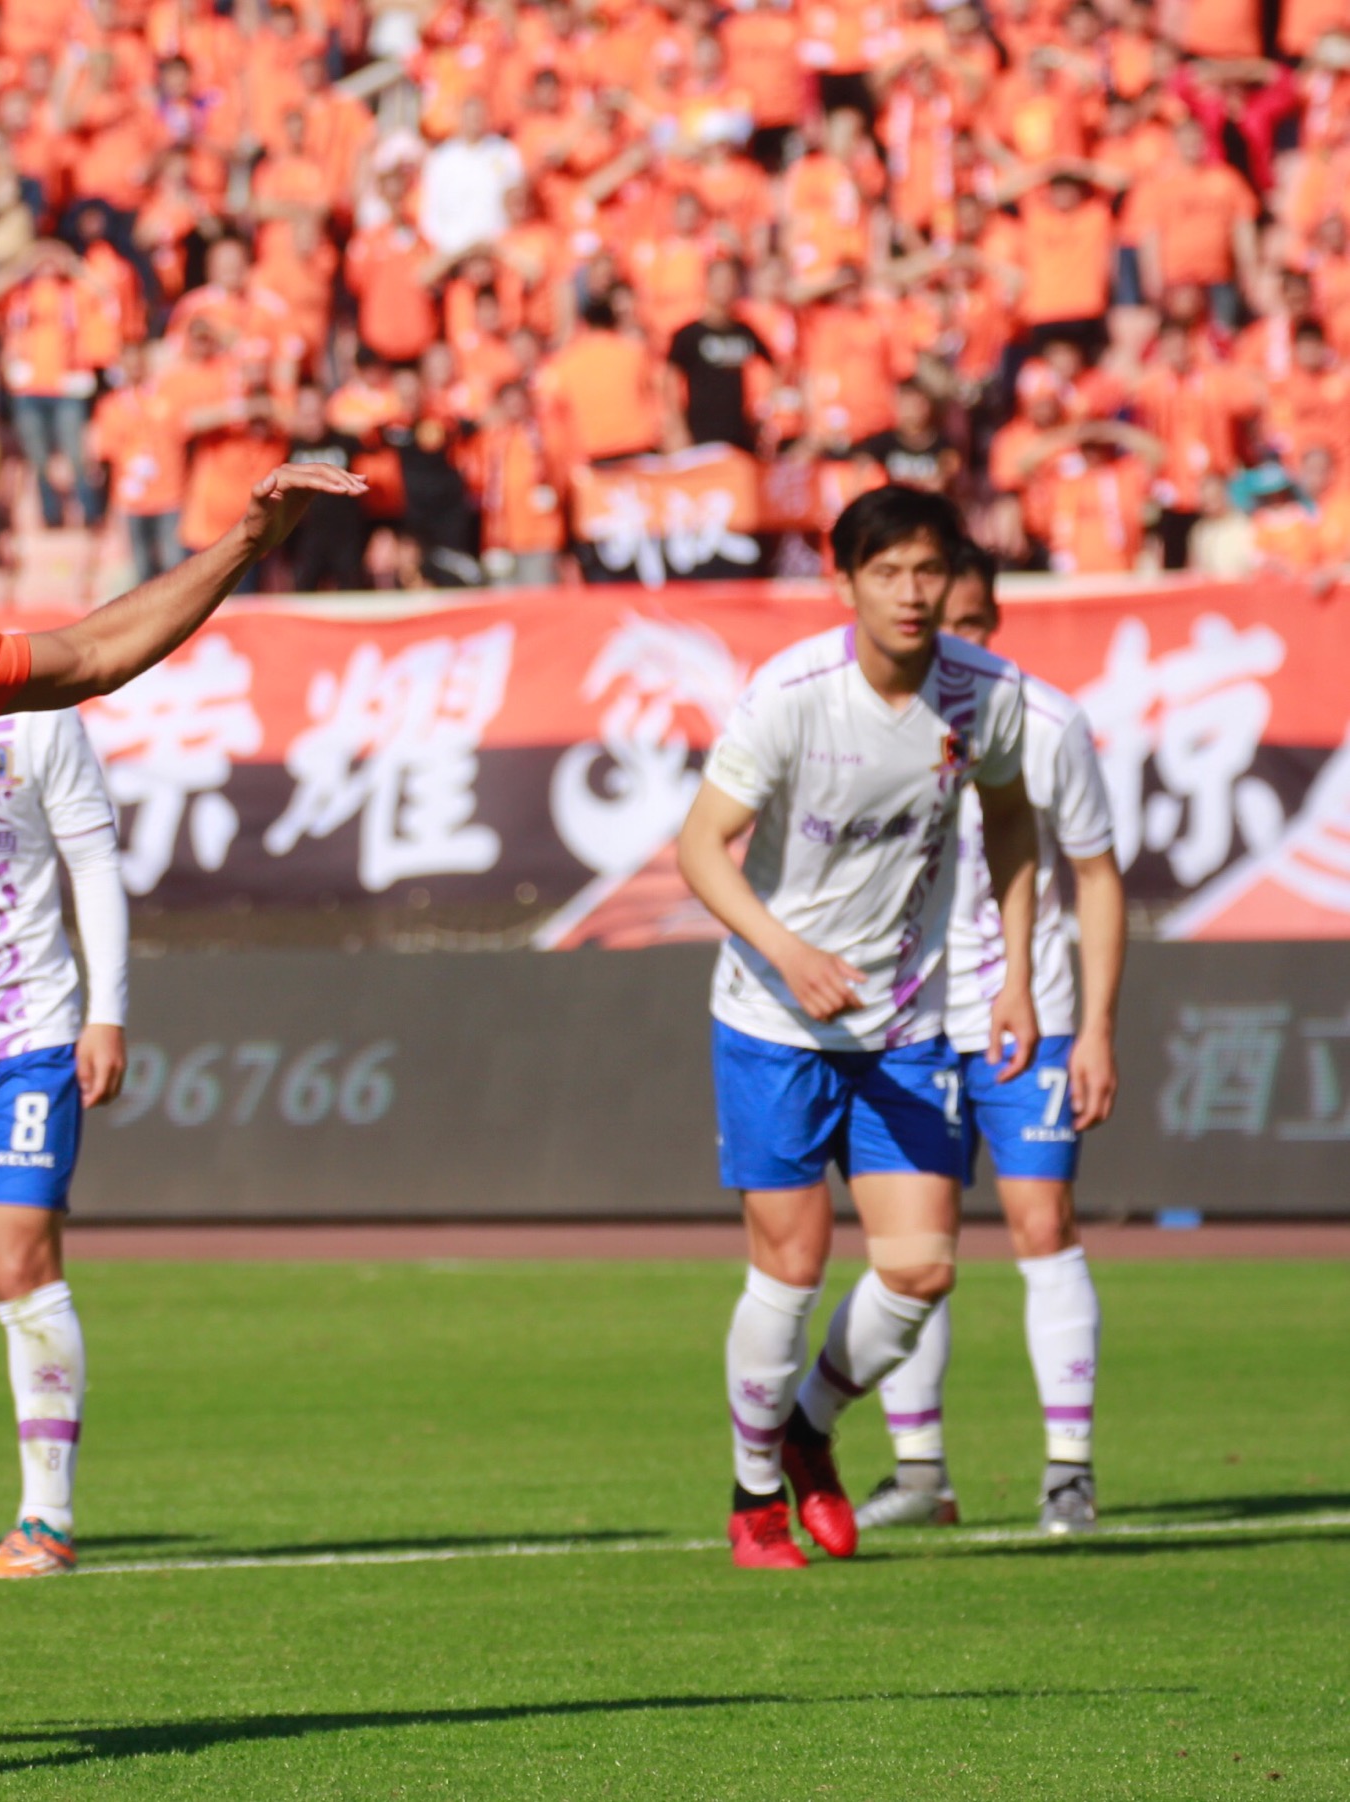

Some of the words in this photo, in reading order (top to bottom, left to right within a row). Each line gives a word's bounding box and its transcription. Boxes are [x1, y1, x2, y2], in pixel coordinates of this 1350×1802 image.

[110, 1040, 398, 1127] 96766
[1038, 1067, 1069, 1127] 7
[10, 1091, 49, 1152] 8
